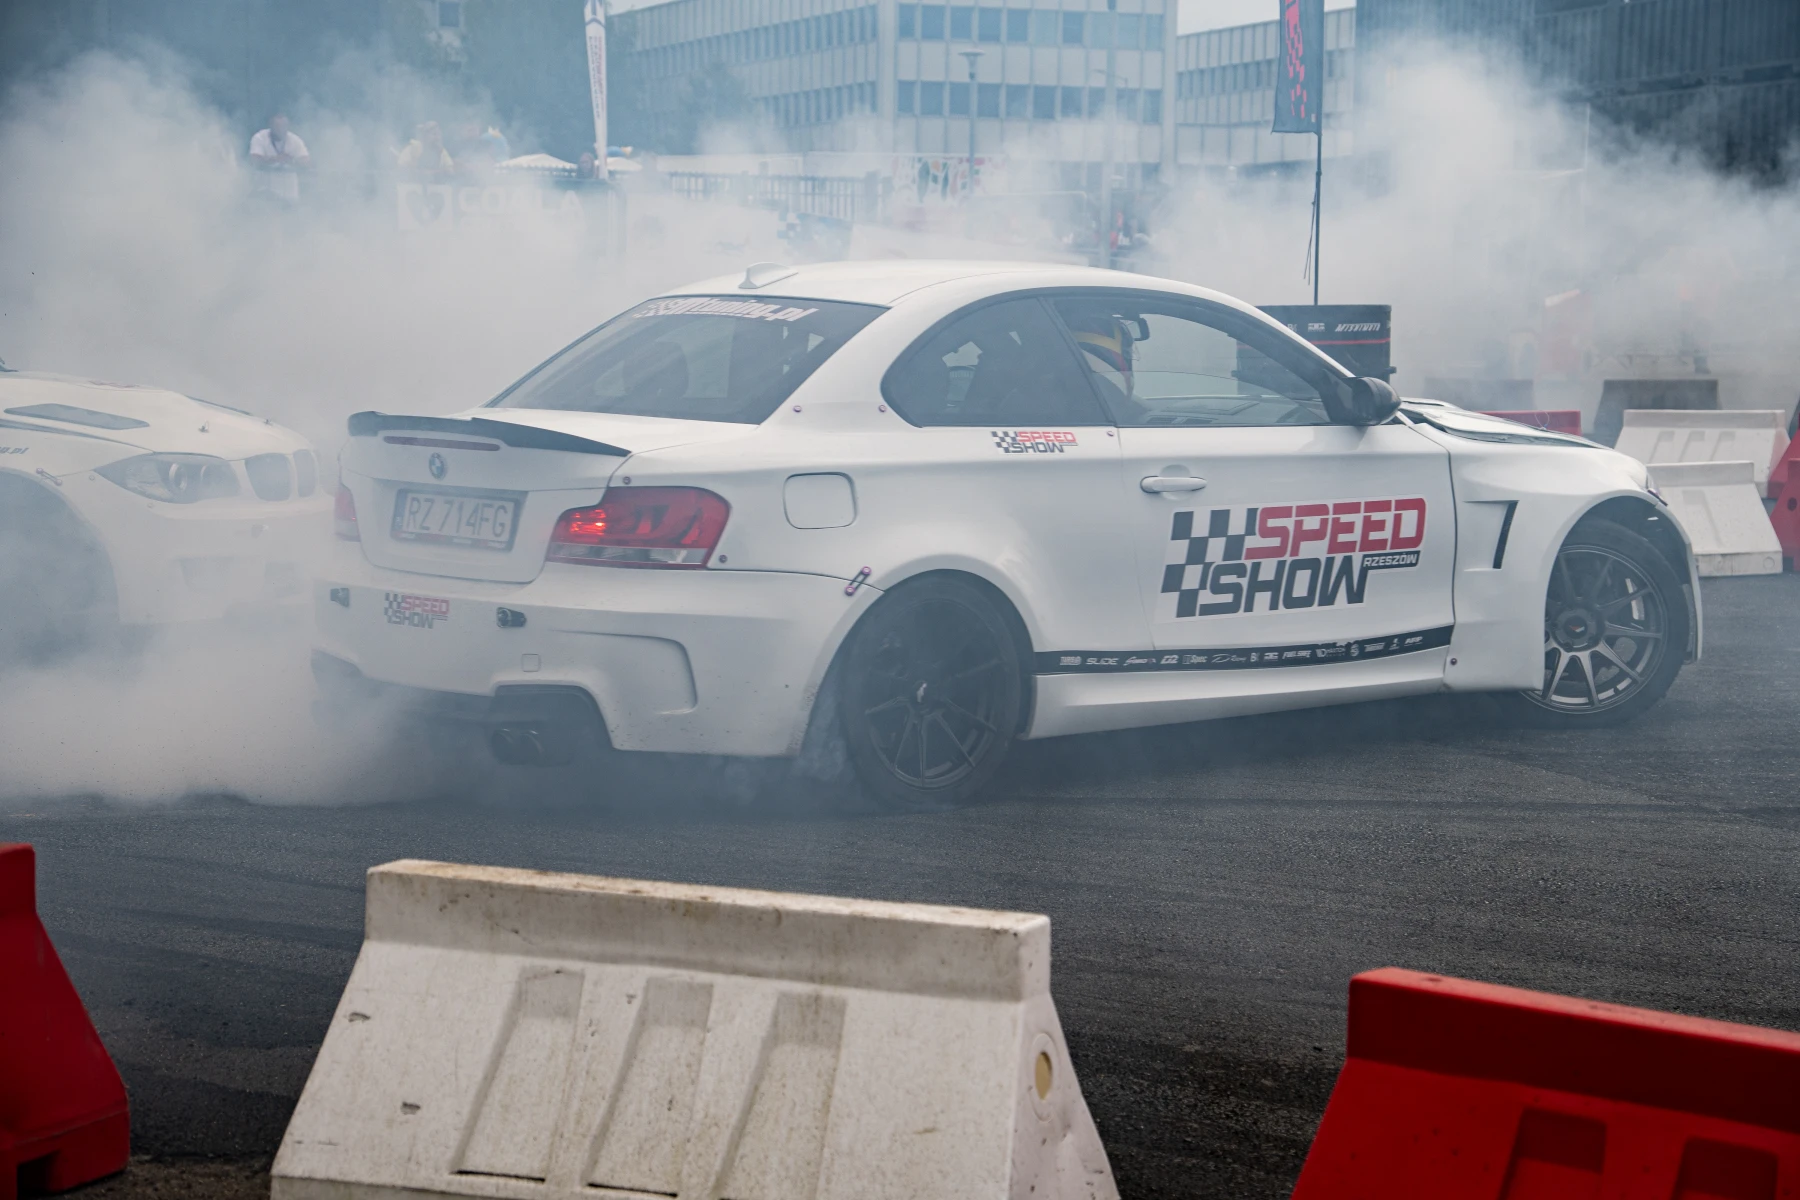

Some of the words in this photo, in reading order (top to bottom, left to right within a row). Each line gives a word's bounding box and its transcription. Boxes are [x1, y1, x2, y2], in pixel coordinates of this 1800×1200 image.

[1018, 431, 1077, 443] SPEED
[1010, 442, 1065, 453] SHOW
[405, 497, 435, 531] RZ
[438, 500, 509, 538] 714FG
[1244, 497, 1426, 560] SPEED
[1363, 553, 1418, 567] RZESZÓW
[1198, 554, 1370, 617] SHOW
[401, 595, 449, 615] SPEED
[389, 609, 434, 629] SHOW
[1085, 657, 1119, 665] SLIDE
